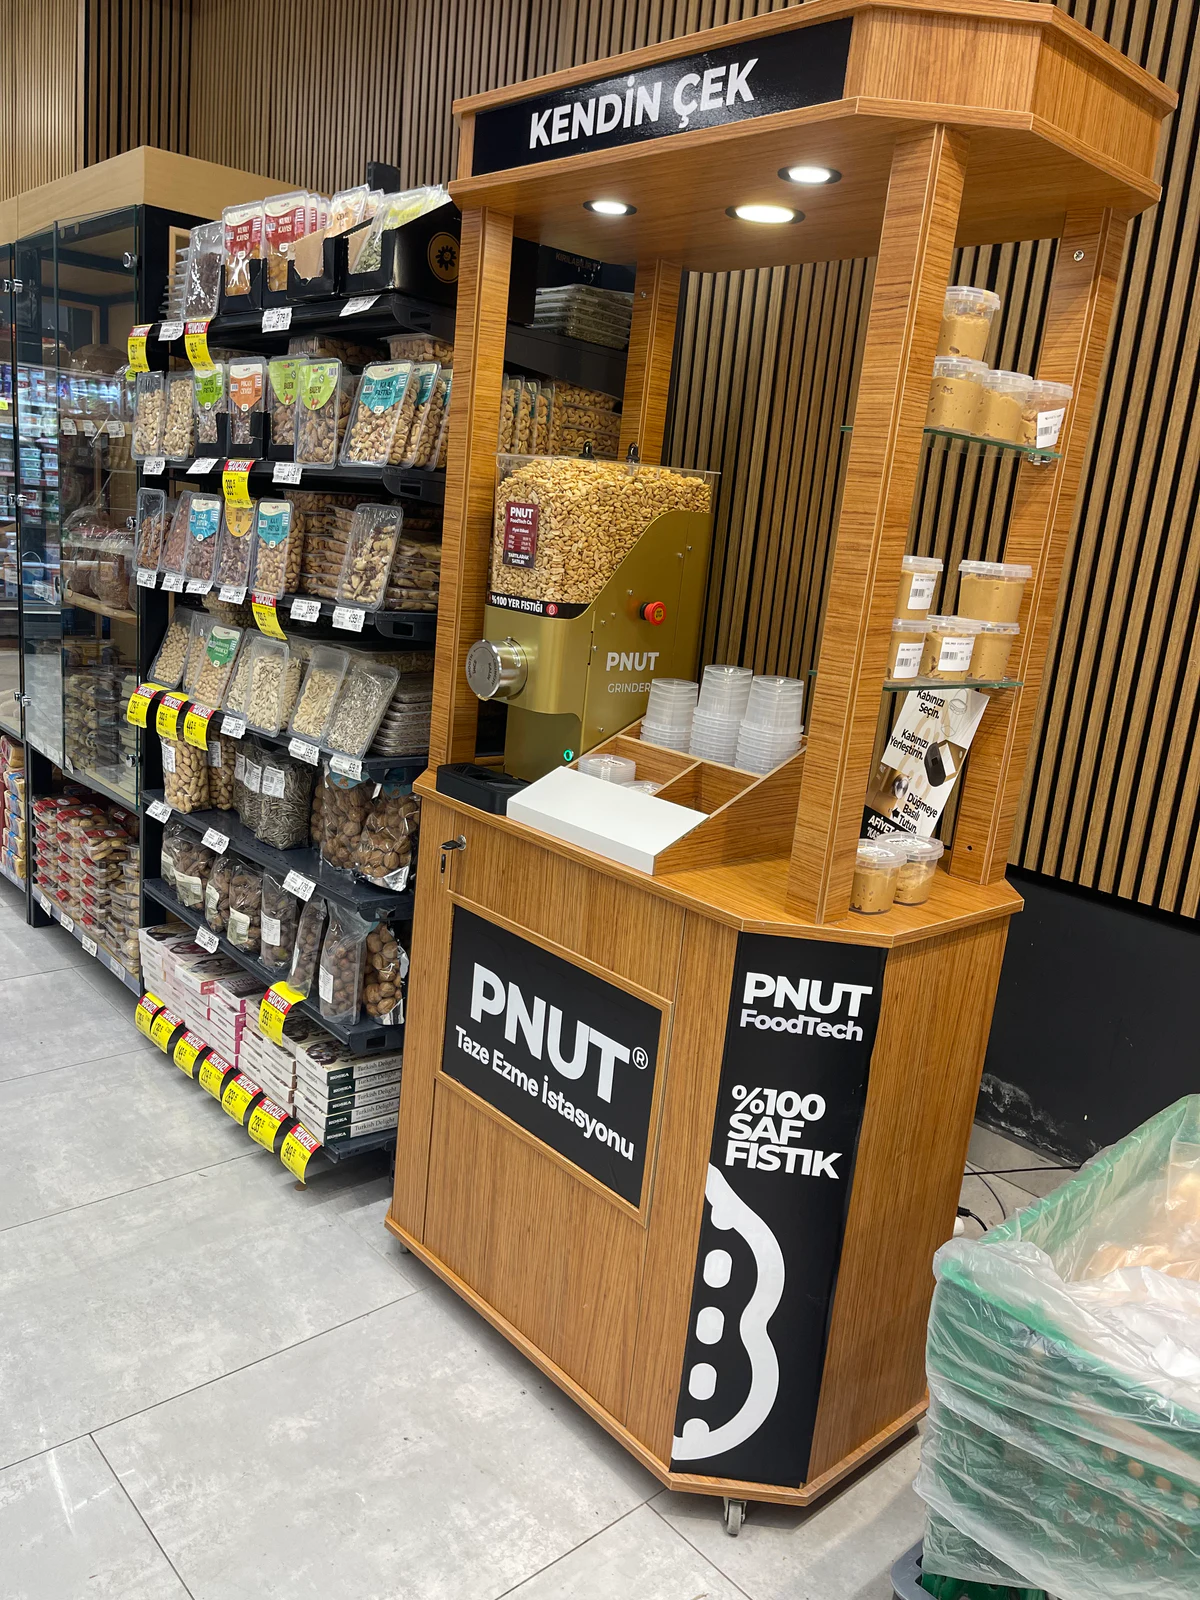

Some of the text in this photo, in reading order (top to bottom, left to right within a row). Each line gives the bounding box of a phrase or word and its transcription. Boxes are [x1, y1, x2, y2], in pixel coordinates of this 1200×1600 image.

[529, 58, 759, 150] KENDİN ÇEK
[510, 506, 534, 518] PNUT
[492, 595, 543, 613] %100 YER FISTIĞI
[606, 652, 660, 672] PNUT
[608, 682, 650, 693] GRINDER
[916, 690, 946, 708] Kabınızı
[918, 702, 940, 719] Seçin.
[890, 736, 924, 760] Yerleştirin.
[901, 728, 930, 750] Kabınızı
[902, 804, 920, 822] Basılı
[906, 792, 938, 818] Düğmeye
[868, 814, 896, 833] AFİYET
[898, 814, 918, 834] Tutun.
[742, 972, 873, 1017] PNUT
[740, 1008, 864, 1042] FoodTech
[358, 1058, 397, 1072] Turkish Delight
[455, 1025, 490, 1065] Taze
[492, 1049, 539, 1097] Ezme
[358, 1076, 378, 1085] Turkish
[378, 1072, 397, 1080] Delight
[358, 1086, 397, 1100] Turkish Delight
[356, 1102, 394, 1116] Turkish Delight
[731, 1084, 826, 1122] %100
[354, 1117, 395, 1131] Turkish Delight
[727, 1112, 805, 1146] SAF
[724, 1139, 843, 1180] FISTIK
